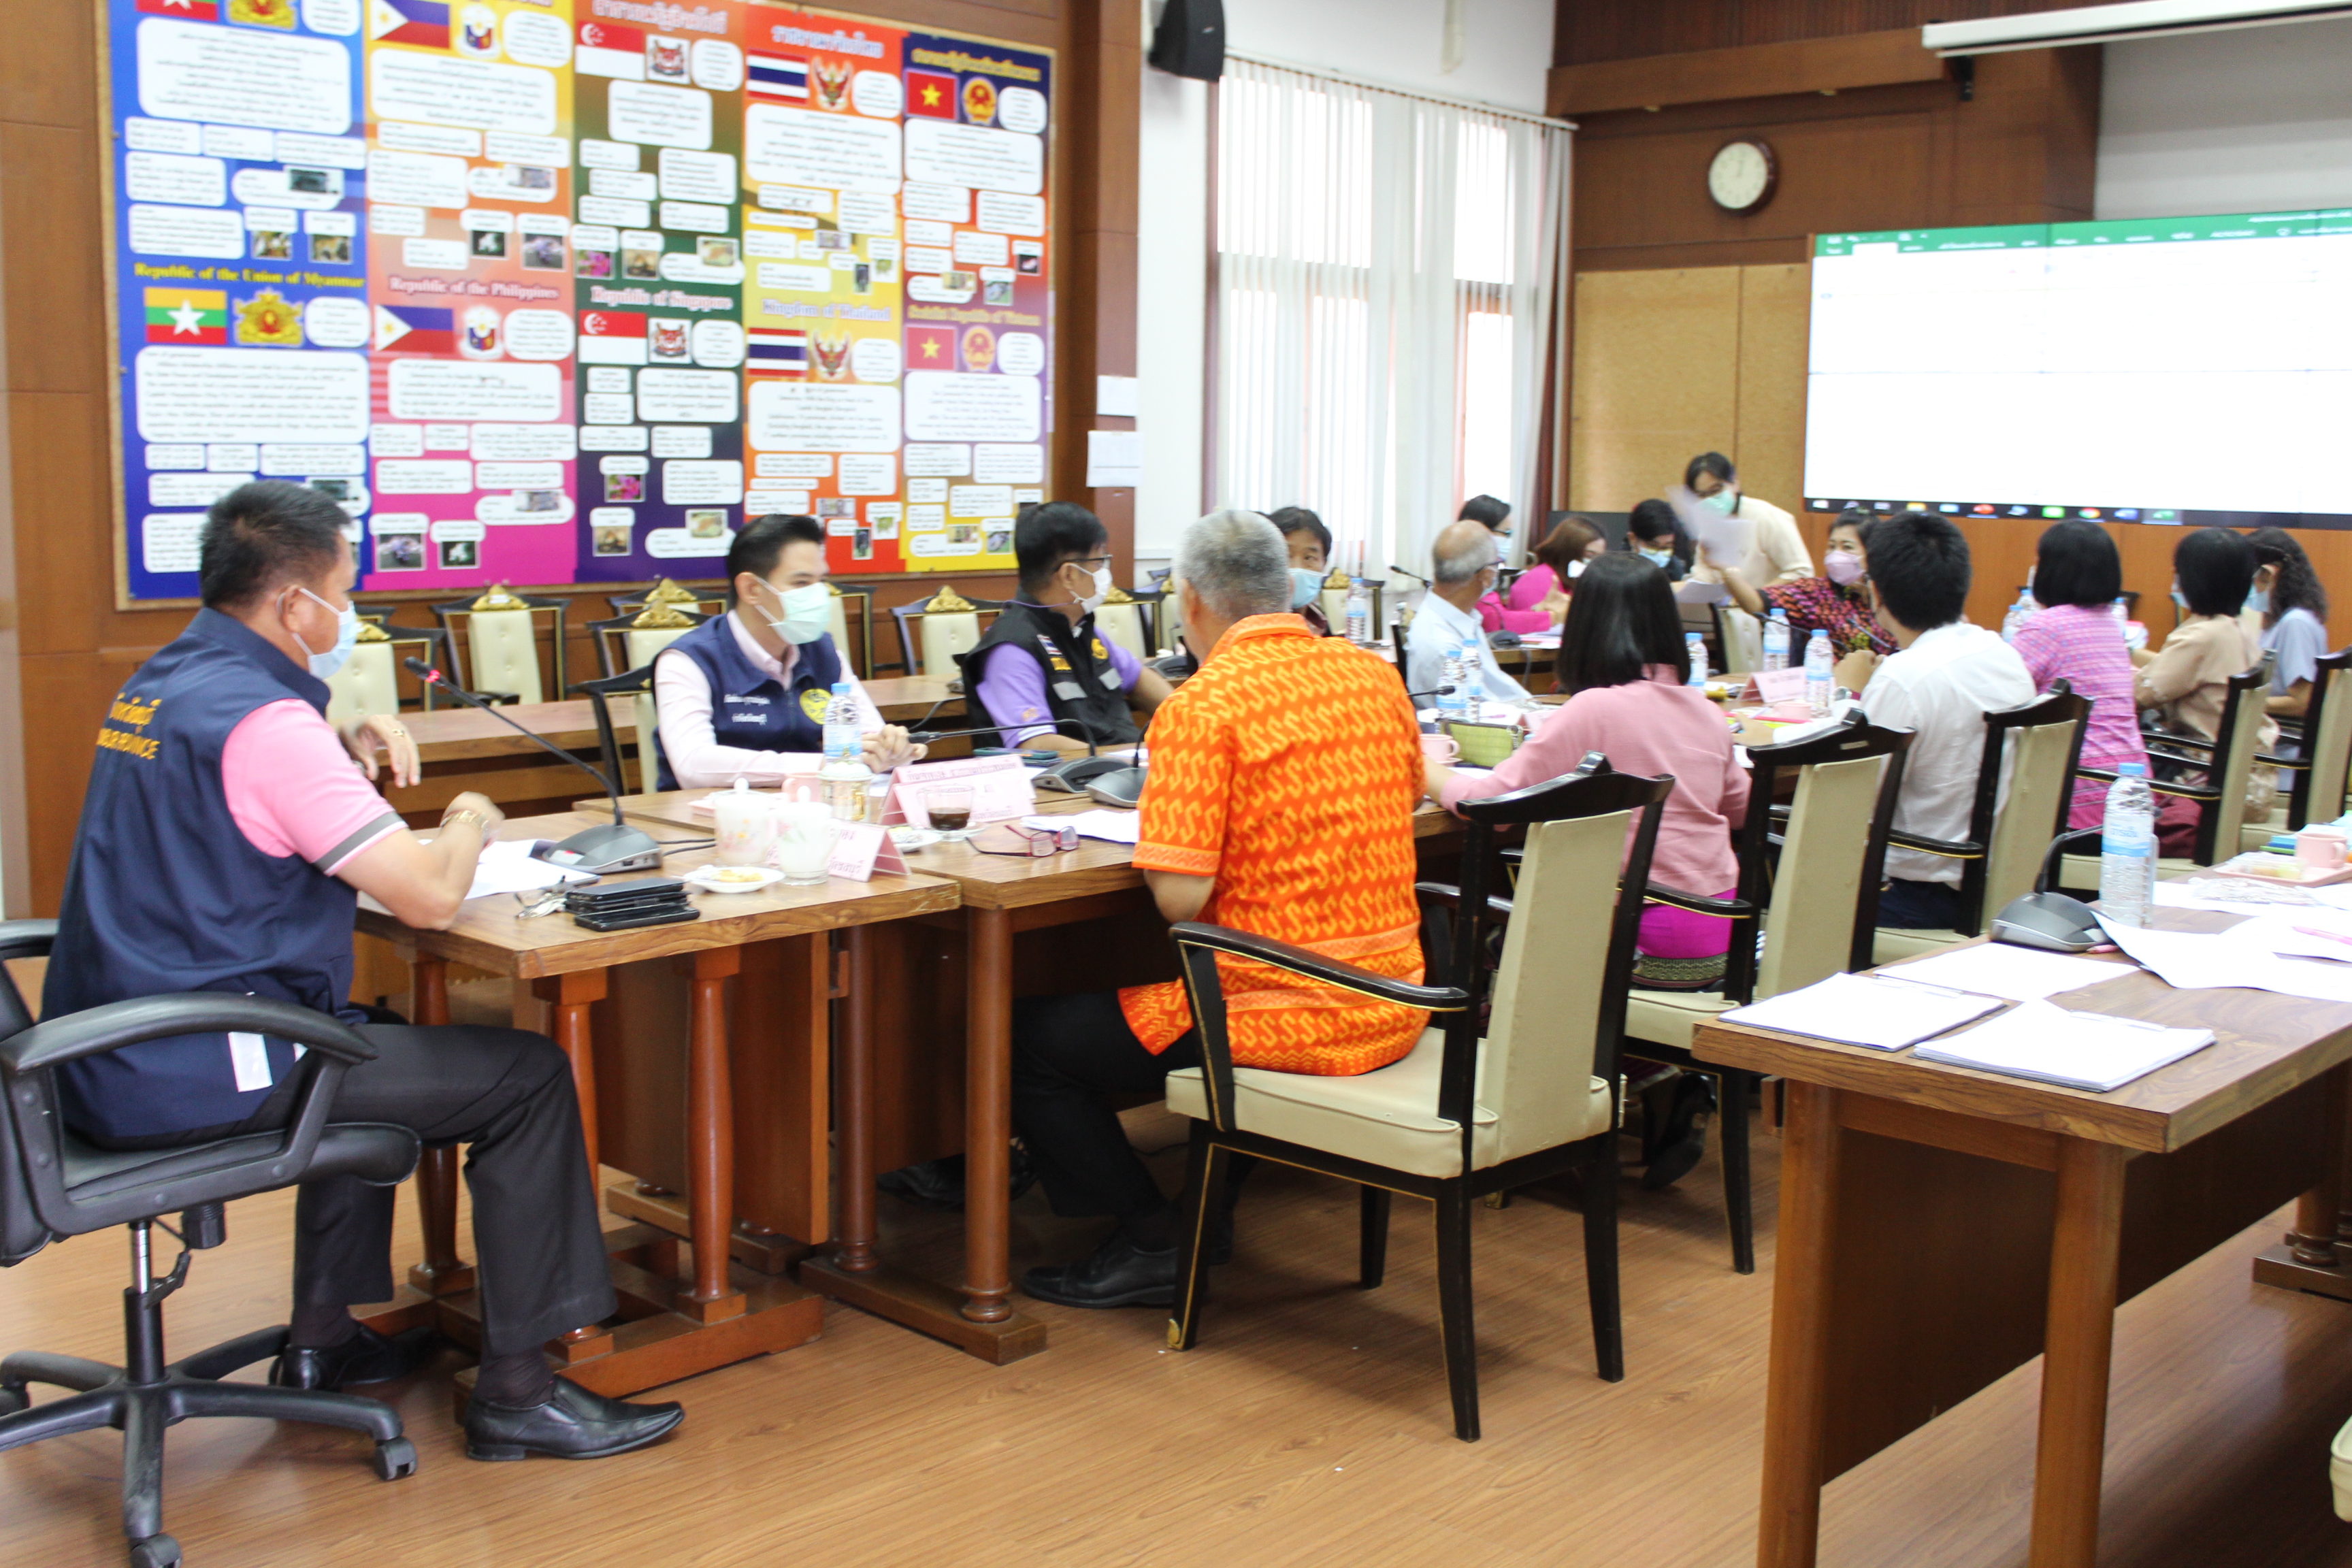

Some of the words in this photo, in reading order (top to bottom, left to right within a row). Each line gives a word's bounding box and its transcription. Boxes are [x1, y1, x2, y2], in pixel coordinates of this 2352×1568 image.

[133, 262, 195, 280] Republic
[198, 266, 215, 280] of
[216, 267, 240, 280] the
[242, 268, 284, 283] Union
[285, 271, 301, 284] of
[303, 272, 365, 288] Myanmar
[389, 276, 447, 295] Republic
[448, 280, 466, 294] of
[466, 280, 489, 295] the
[490, 282, 559, 300] Philippines
[590, 285, 651, 307] Republic
[652, 290, 669, 306] of
[669, 291, 734, 312] Singapore
[762, 298, 819, 318] Kingdom
[821, 303, 836, 318] of
